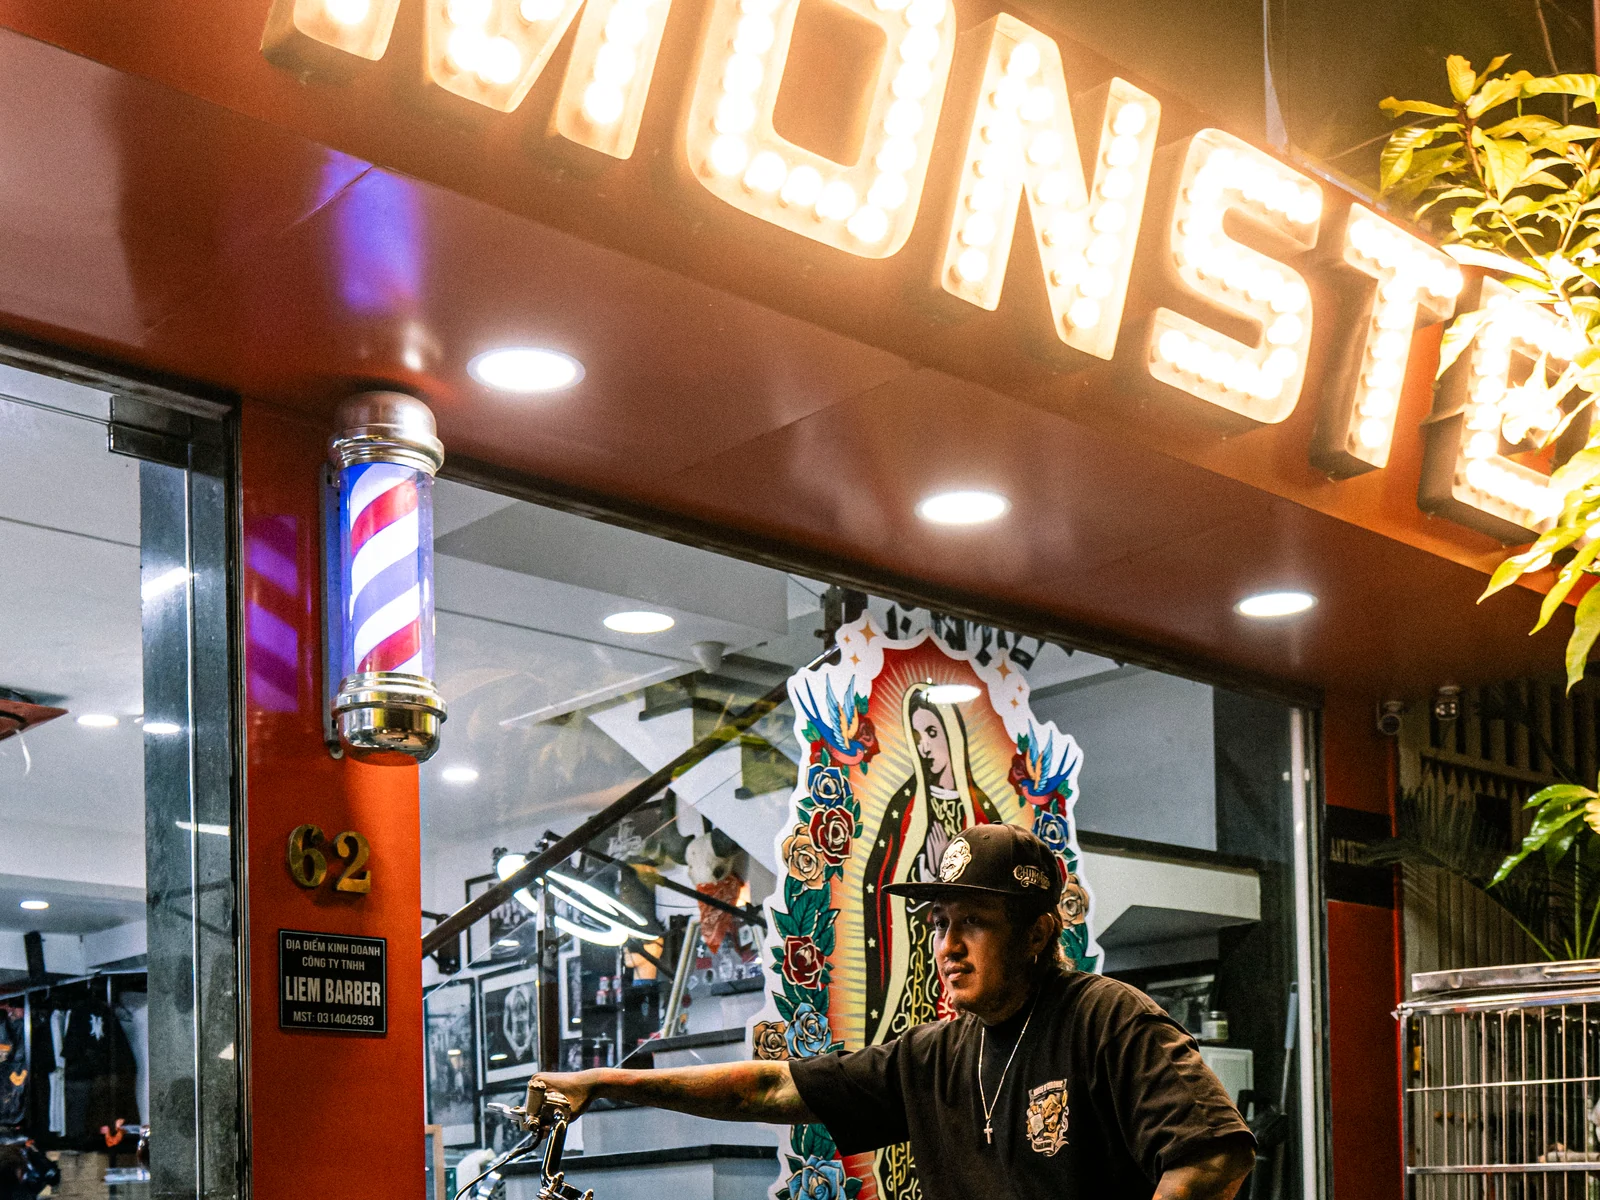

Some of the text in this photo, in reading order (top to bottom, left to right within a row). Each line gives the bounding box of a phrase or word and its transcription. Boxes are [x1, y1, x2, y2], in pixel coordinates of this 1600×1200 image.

[288, 823, 372, 893] 62
[285, 937, 381, 957] ĐỊA ĐIỂM KINH DOANH
[302, 955, 365, 971] CÔNG TY TNHH
[285, 975, 381, 1007] LIEM BARBER
[293, 1011, 375, 1026] MST: 0314042593
